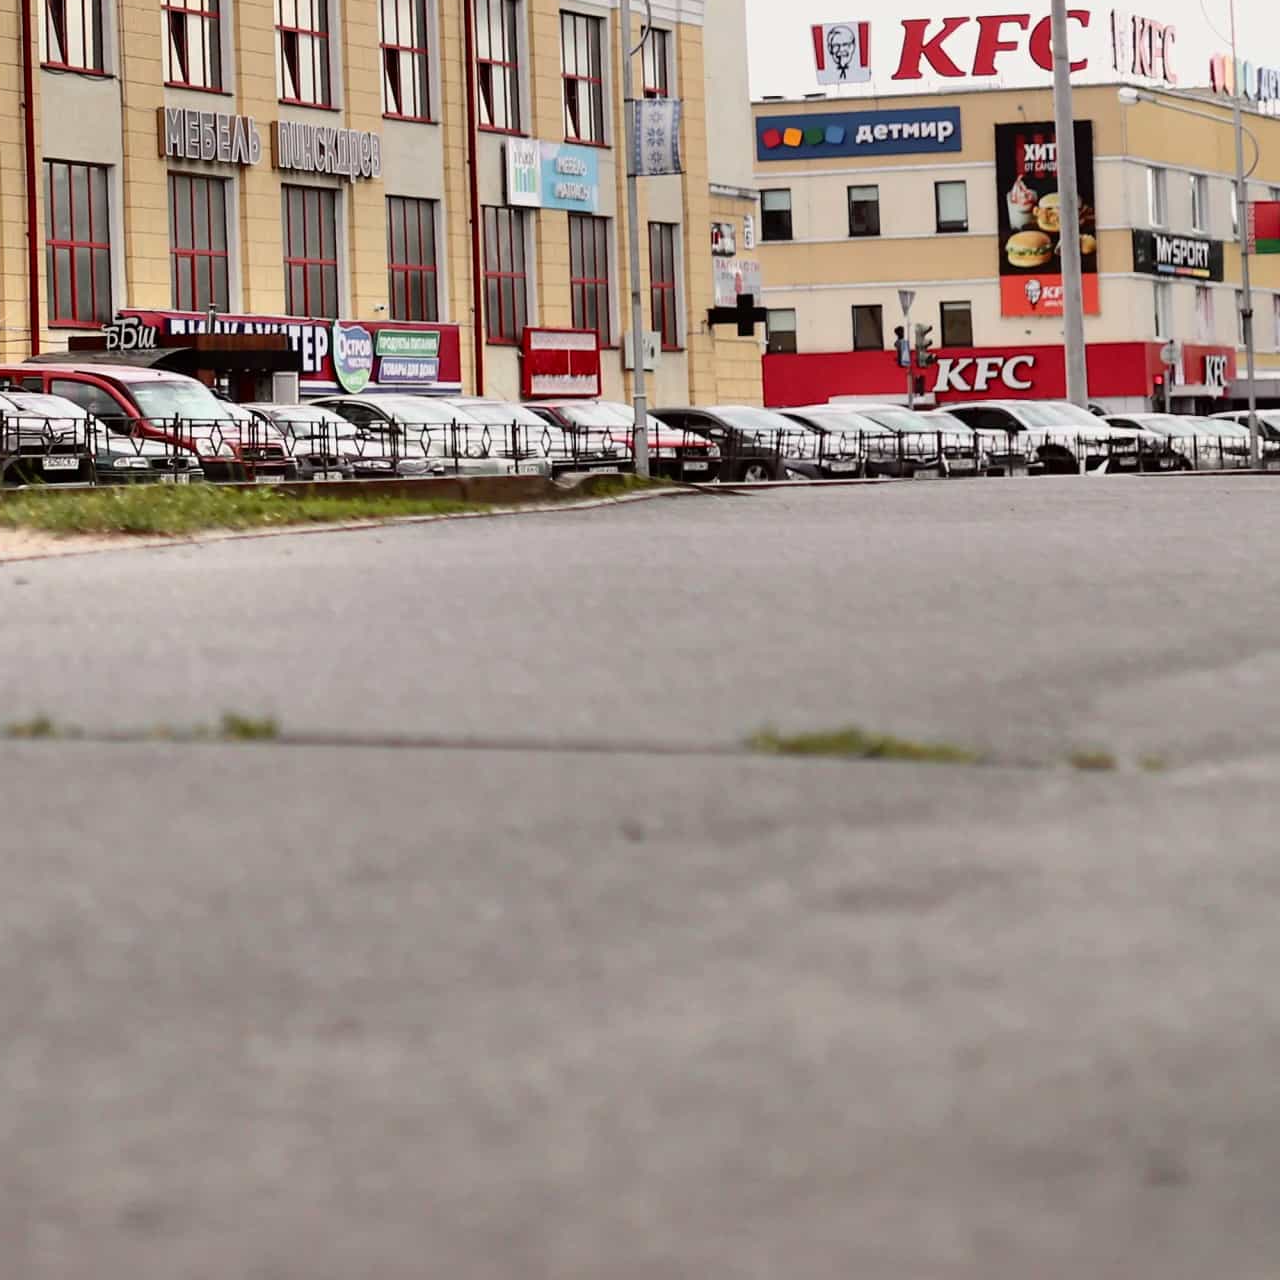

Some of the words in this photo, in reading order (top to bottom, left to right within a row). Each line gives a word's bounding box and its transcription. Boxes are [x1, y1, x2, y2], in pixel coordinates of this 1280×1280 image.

[891, 10, 1090, 80] KFC
[1132, 15, 1177, 84] KFC
[164, 107, 261, 165] МЕБЕЛЬ
[855, 121, 954, 144] детмир
[1024, 144, 1057, 161] ХИТ
[1042, 286, 1064, 298] KF
[932, 355, 1034, 391] KFC
[1206, 355, 1227, 387] KFC
